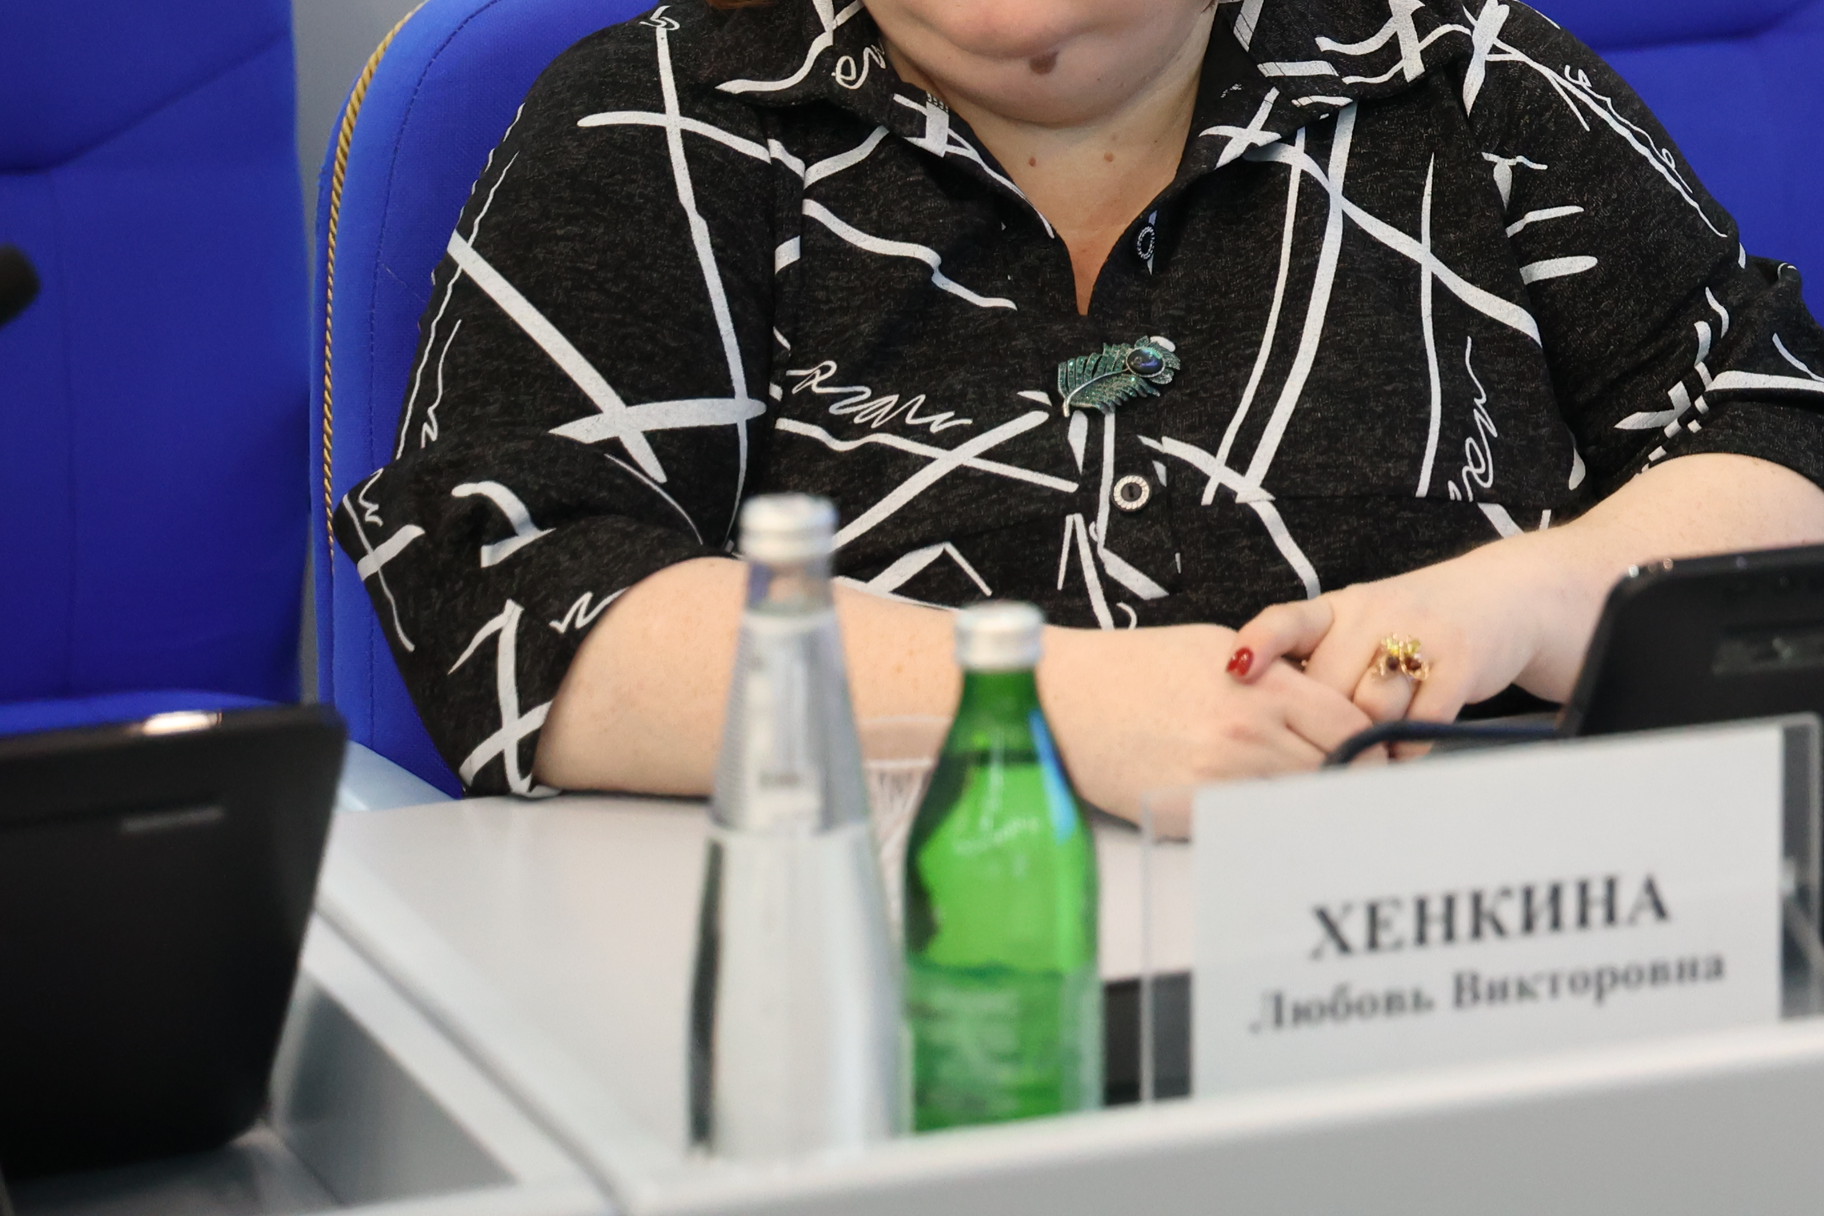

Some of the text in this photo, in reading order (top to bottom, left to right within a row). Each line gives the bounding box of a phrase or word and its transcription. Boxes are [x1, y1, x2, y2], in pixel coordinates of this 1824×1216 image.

[1309, 874, 1671, 960] ХЕНКИНА
[1248, 952, 1726, 1034] Любовь Викторовна
